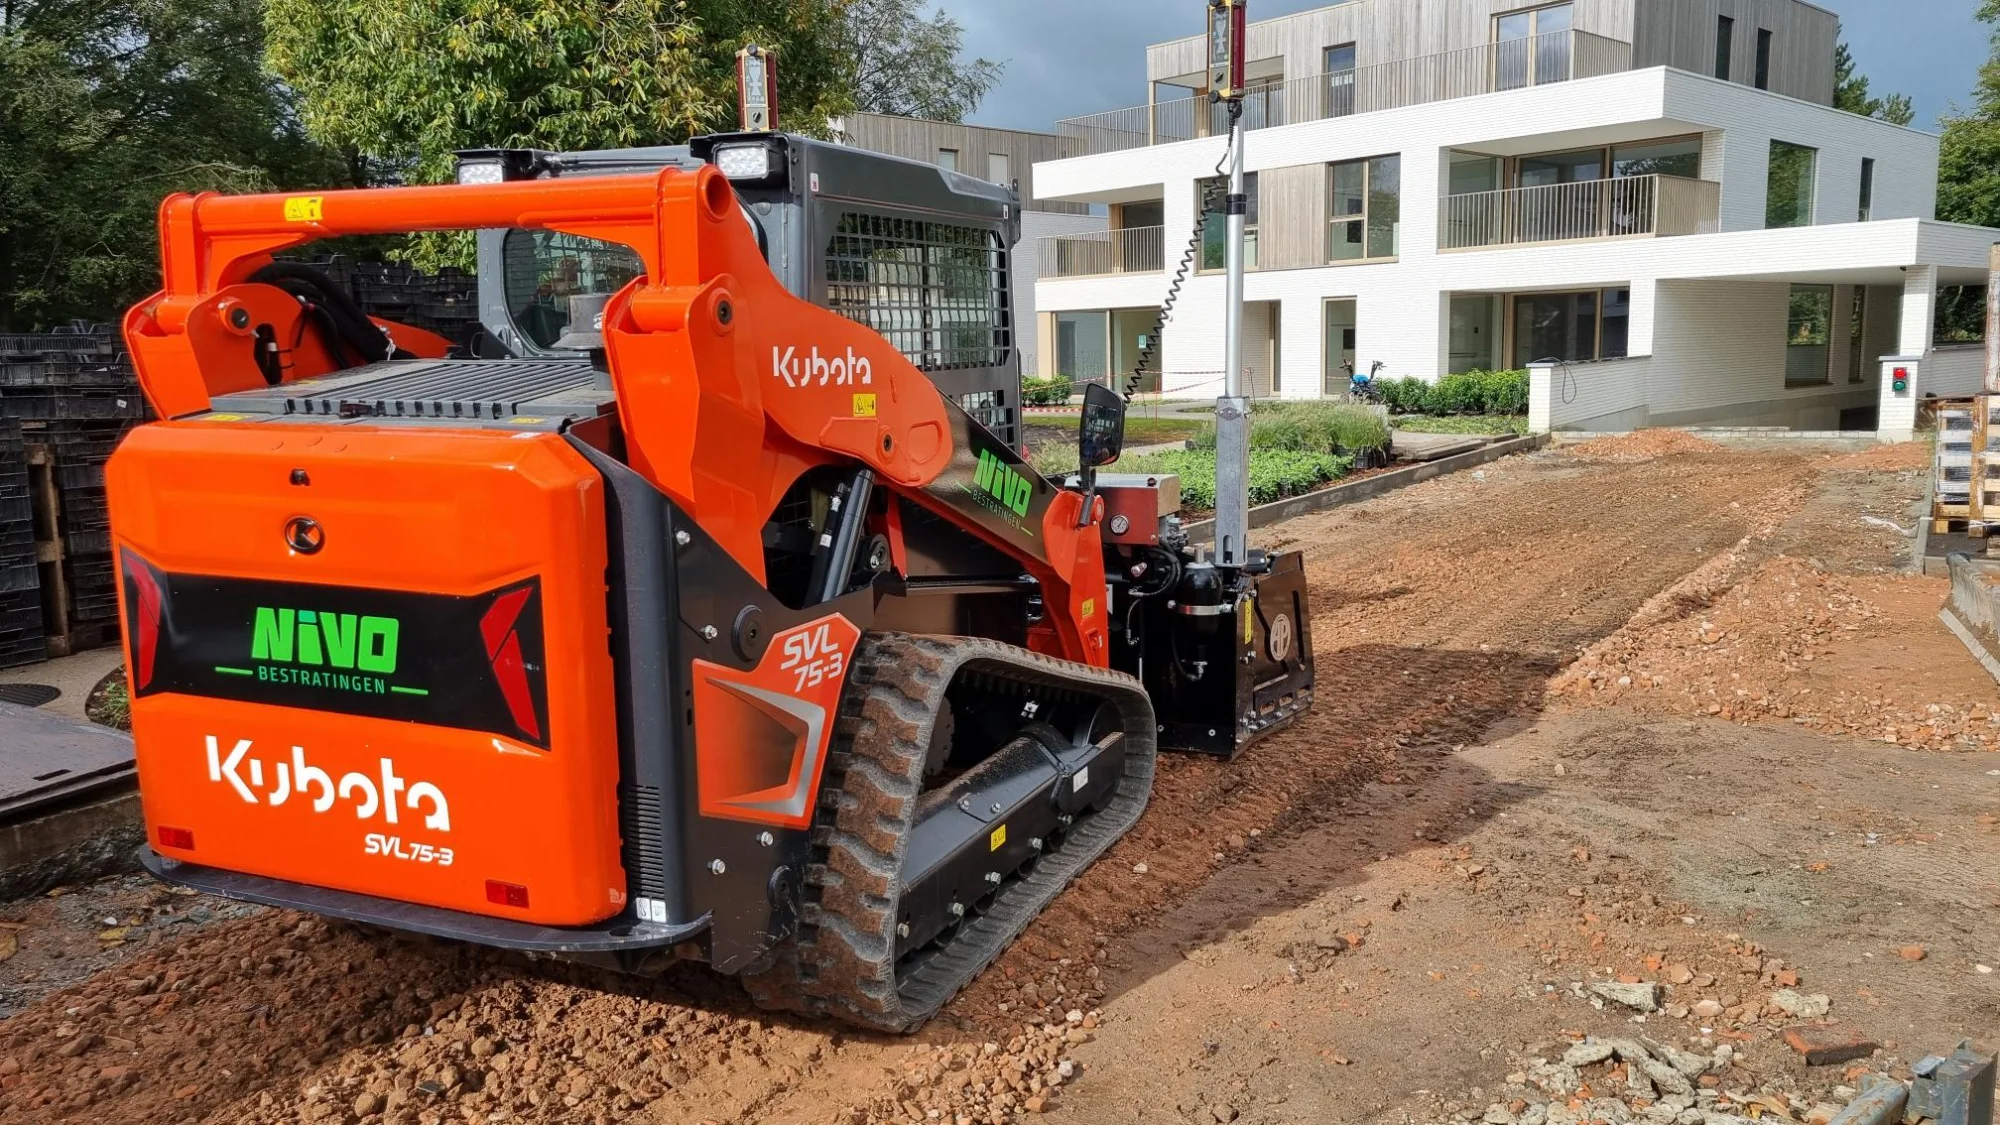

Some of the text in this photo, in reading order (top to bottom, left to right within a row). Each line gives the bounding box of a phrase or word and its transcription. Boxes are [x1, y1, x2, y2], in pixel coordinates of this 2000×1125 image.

[773, 346, 872, 388] Kubota
[972, 489, 1021, 530] BESTRATINGEN
[780, 623, 839, 671] SVL
[258, 665, 385, 694] BESTRATINGEN
[794, 652, 843, 693] 75-3
[205, 734, 451, 832] Kubota
